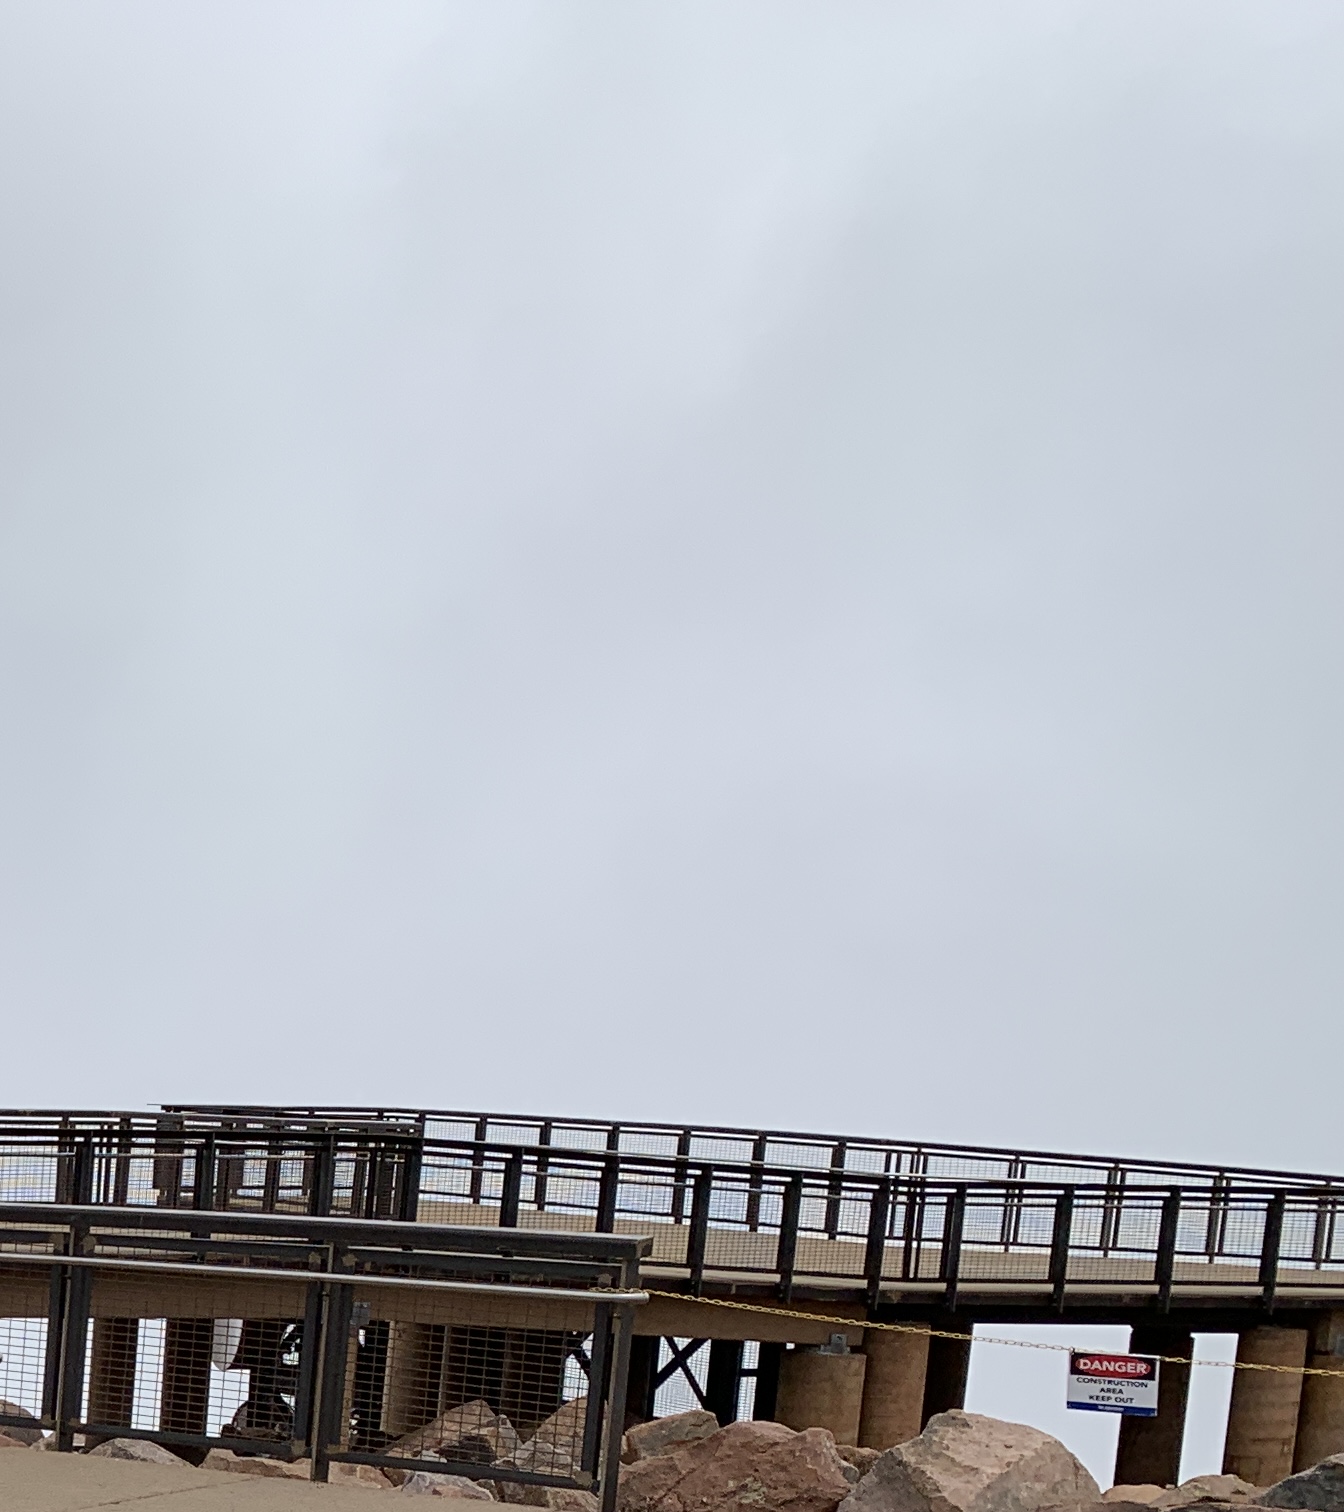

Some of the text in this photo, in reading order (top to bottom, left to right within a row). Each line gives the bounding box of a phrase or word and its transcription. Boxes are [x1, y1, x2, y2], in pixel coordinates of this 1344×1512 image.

[1079, 1358, 1147, 1374] DANGER
[1076, 1377, 1148, 1388] CONSTRUCTION
[1099, 1387, 1124, 1395] AREA
